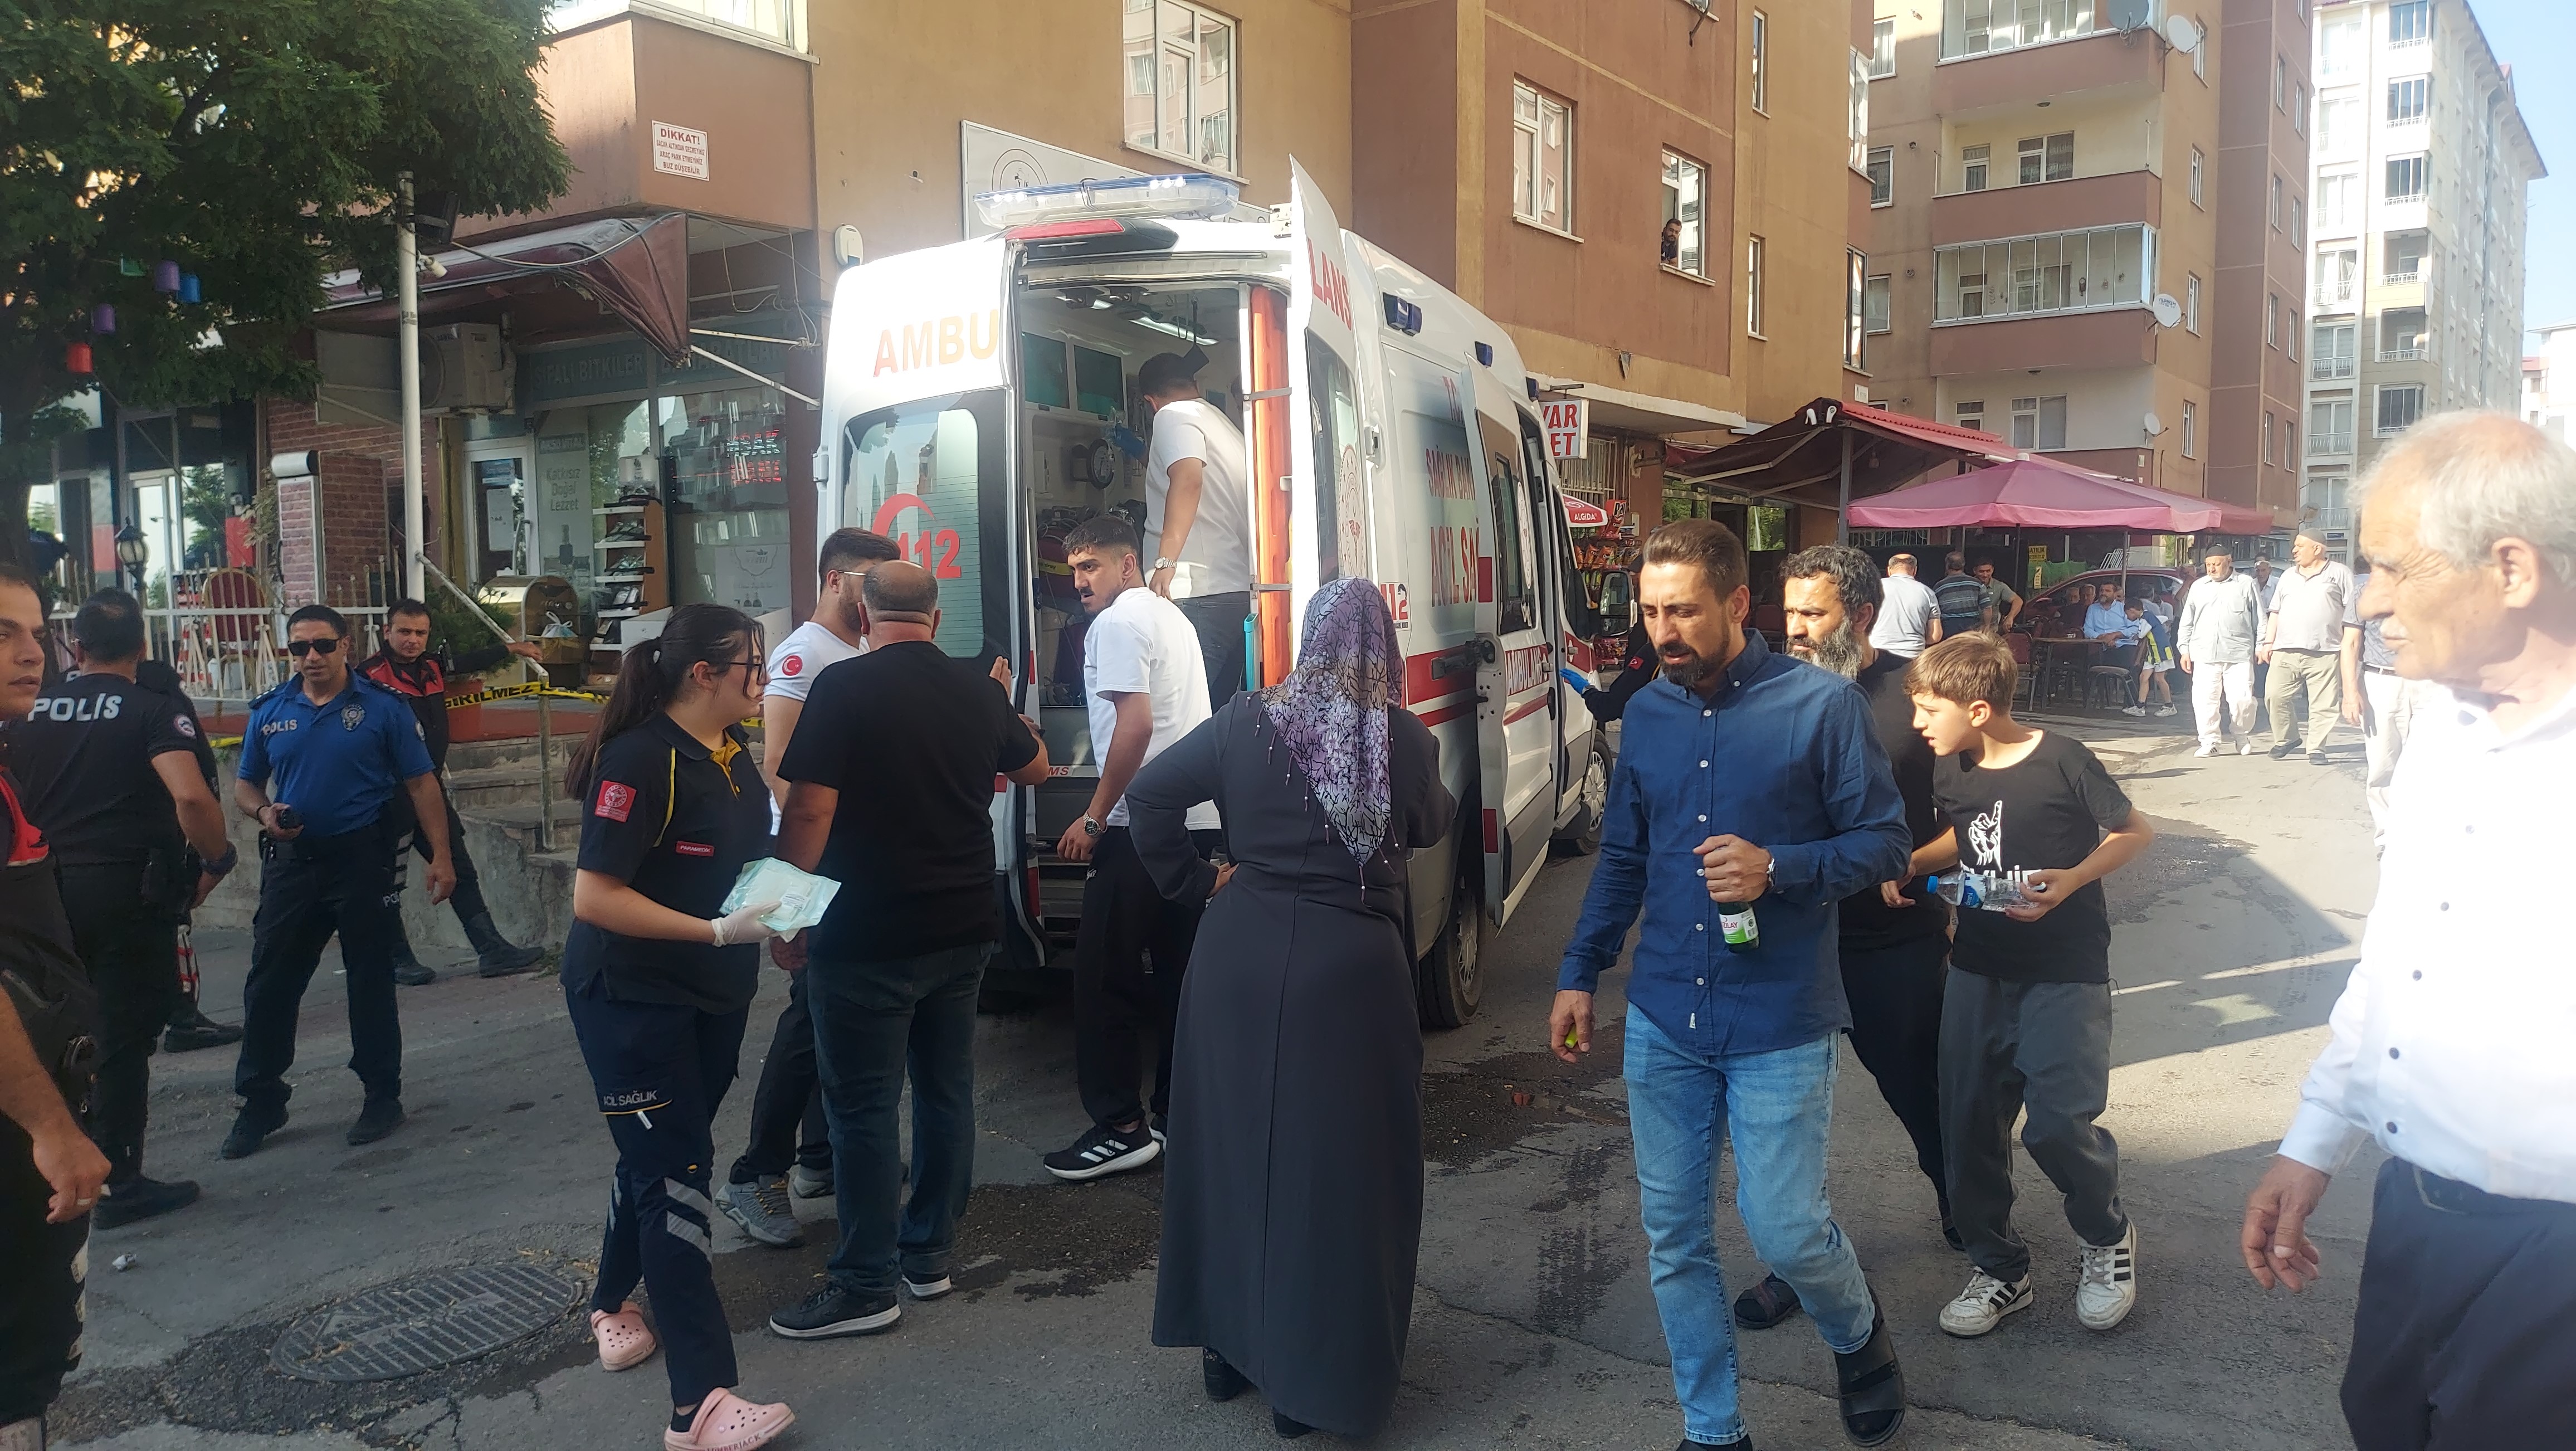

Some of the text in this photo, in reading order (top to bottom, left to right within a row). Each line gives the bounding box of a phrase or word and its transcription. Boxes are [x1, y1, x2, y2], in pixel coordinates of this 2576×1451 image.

[661, 128, 700, 144] DİKKAT!
[671, 153, 681, 161] PARK
[1307, 238, 1353, 331] LANS
[872, 309, 1000, 378] AMBU
[1550, 432, 1576, 456] ET
[1430, 525, 1460, 607] ACİL
[1507, 646, 1543, 696] AMBULANS
[619, 1090, 658, 1106] SAĞLIK
